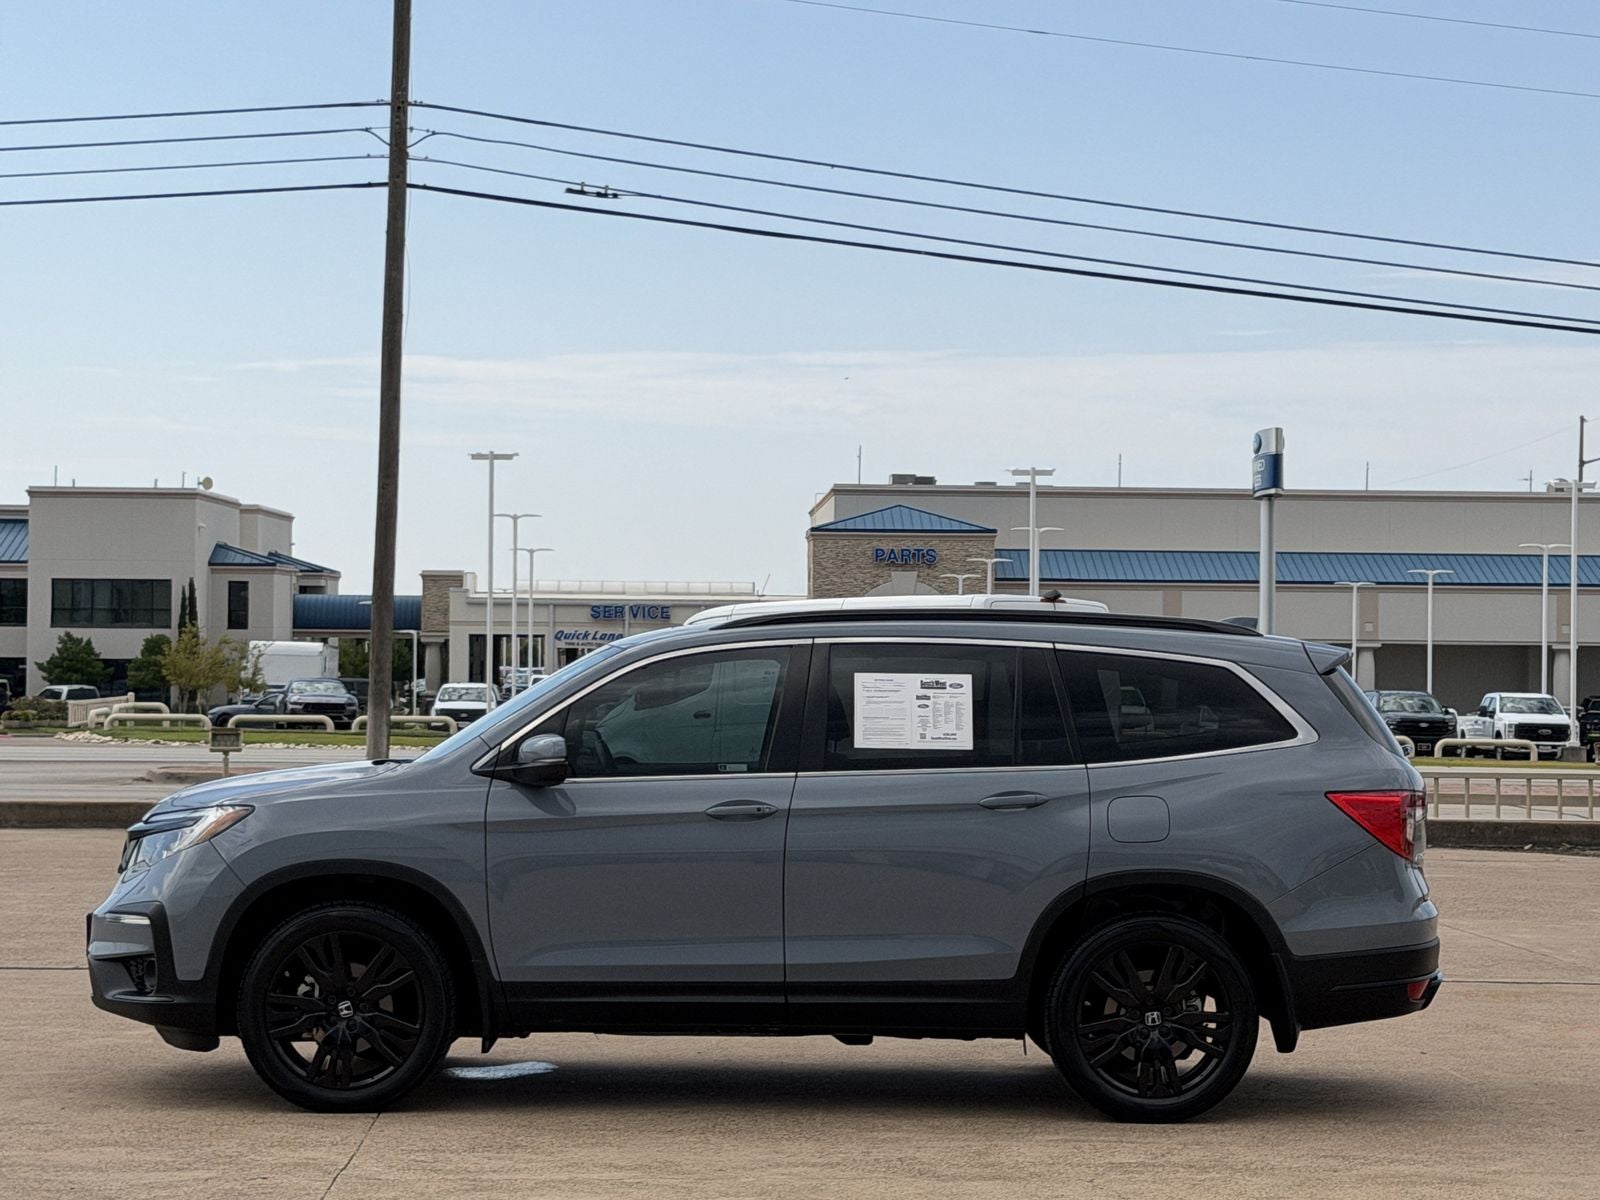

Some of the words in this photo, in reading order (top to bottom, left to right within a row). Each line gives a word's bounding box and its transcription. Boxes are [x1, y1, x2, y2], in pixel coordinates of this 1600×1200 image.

[874, 547, 938, 565] PARTS
[590, 604, 671, 620] SERVICE
[554, 629, 591, 641] Quick
[592, 630, 624, 641] Lane
